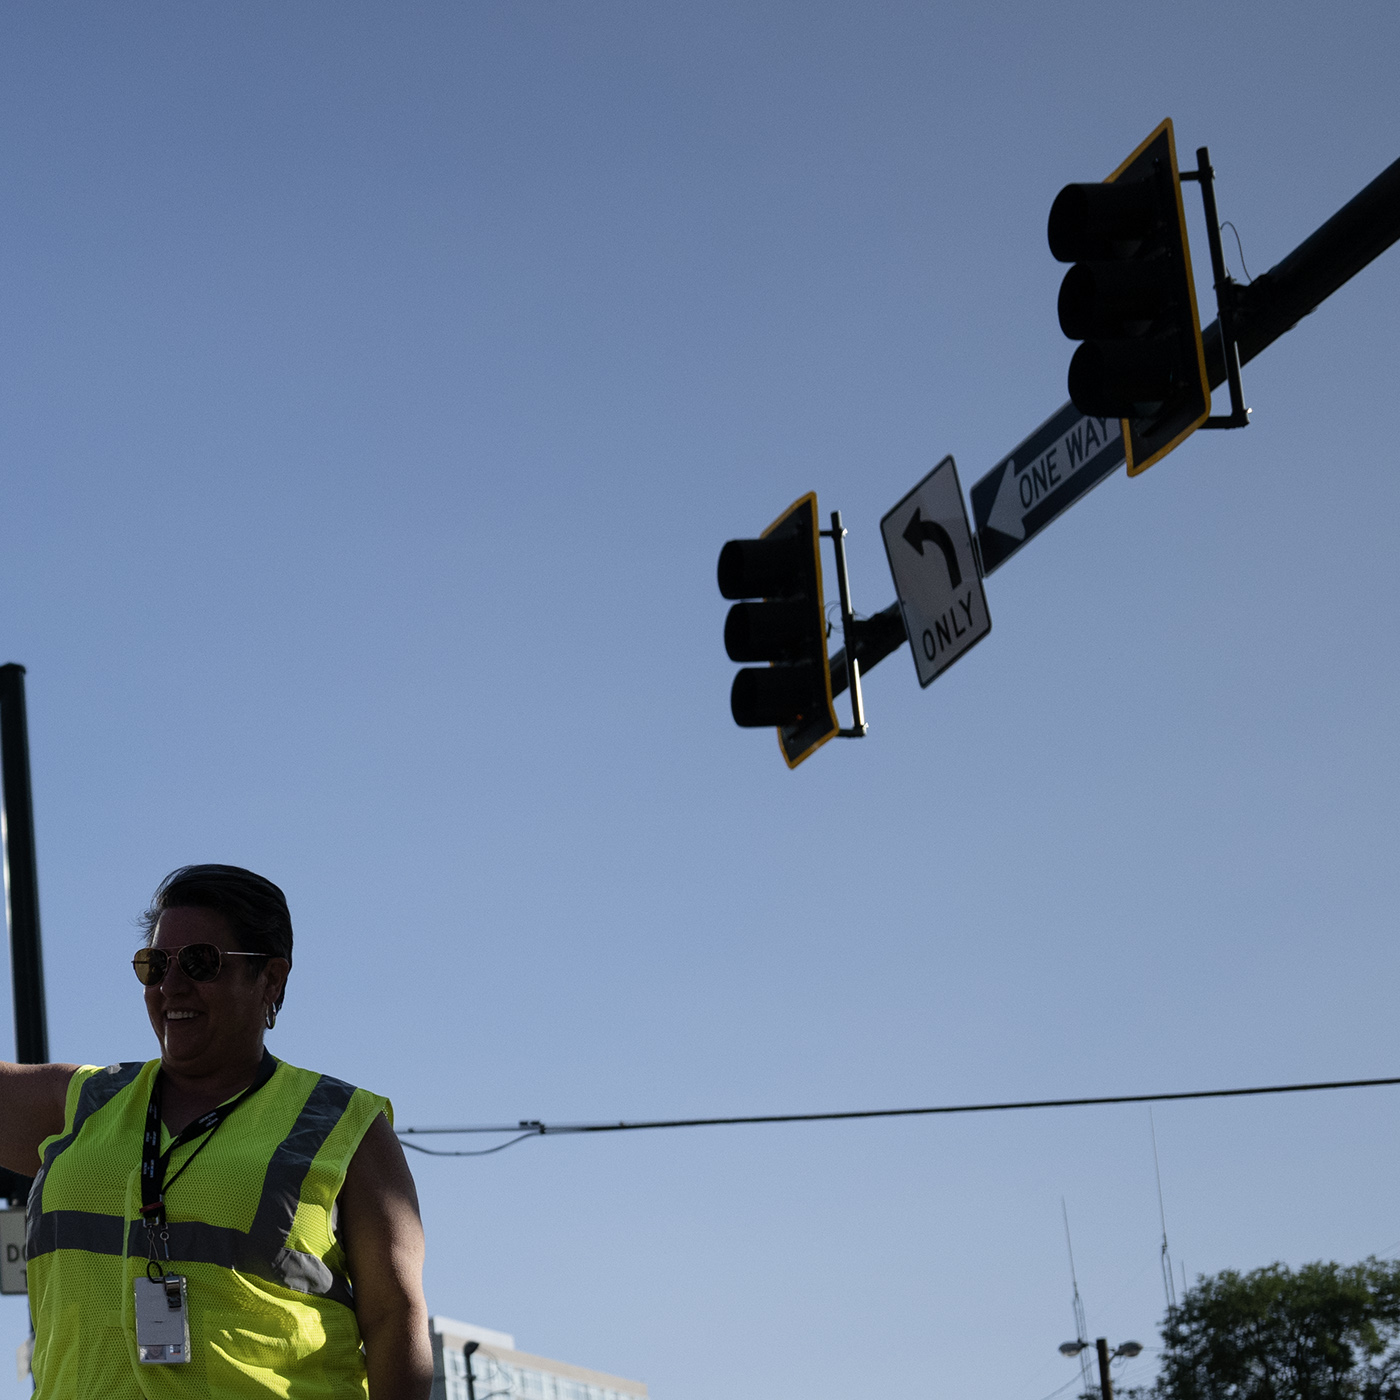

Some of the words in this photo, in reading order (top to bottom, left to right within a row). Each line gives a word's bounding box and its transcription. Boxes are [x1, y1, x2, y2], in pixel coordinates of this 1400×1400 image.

[1019, 447, 1062, 509] ONE
[1065, 417, 1108, 469] WAY
[922, 590, 973, 662] ONLY
